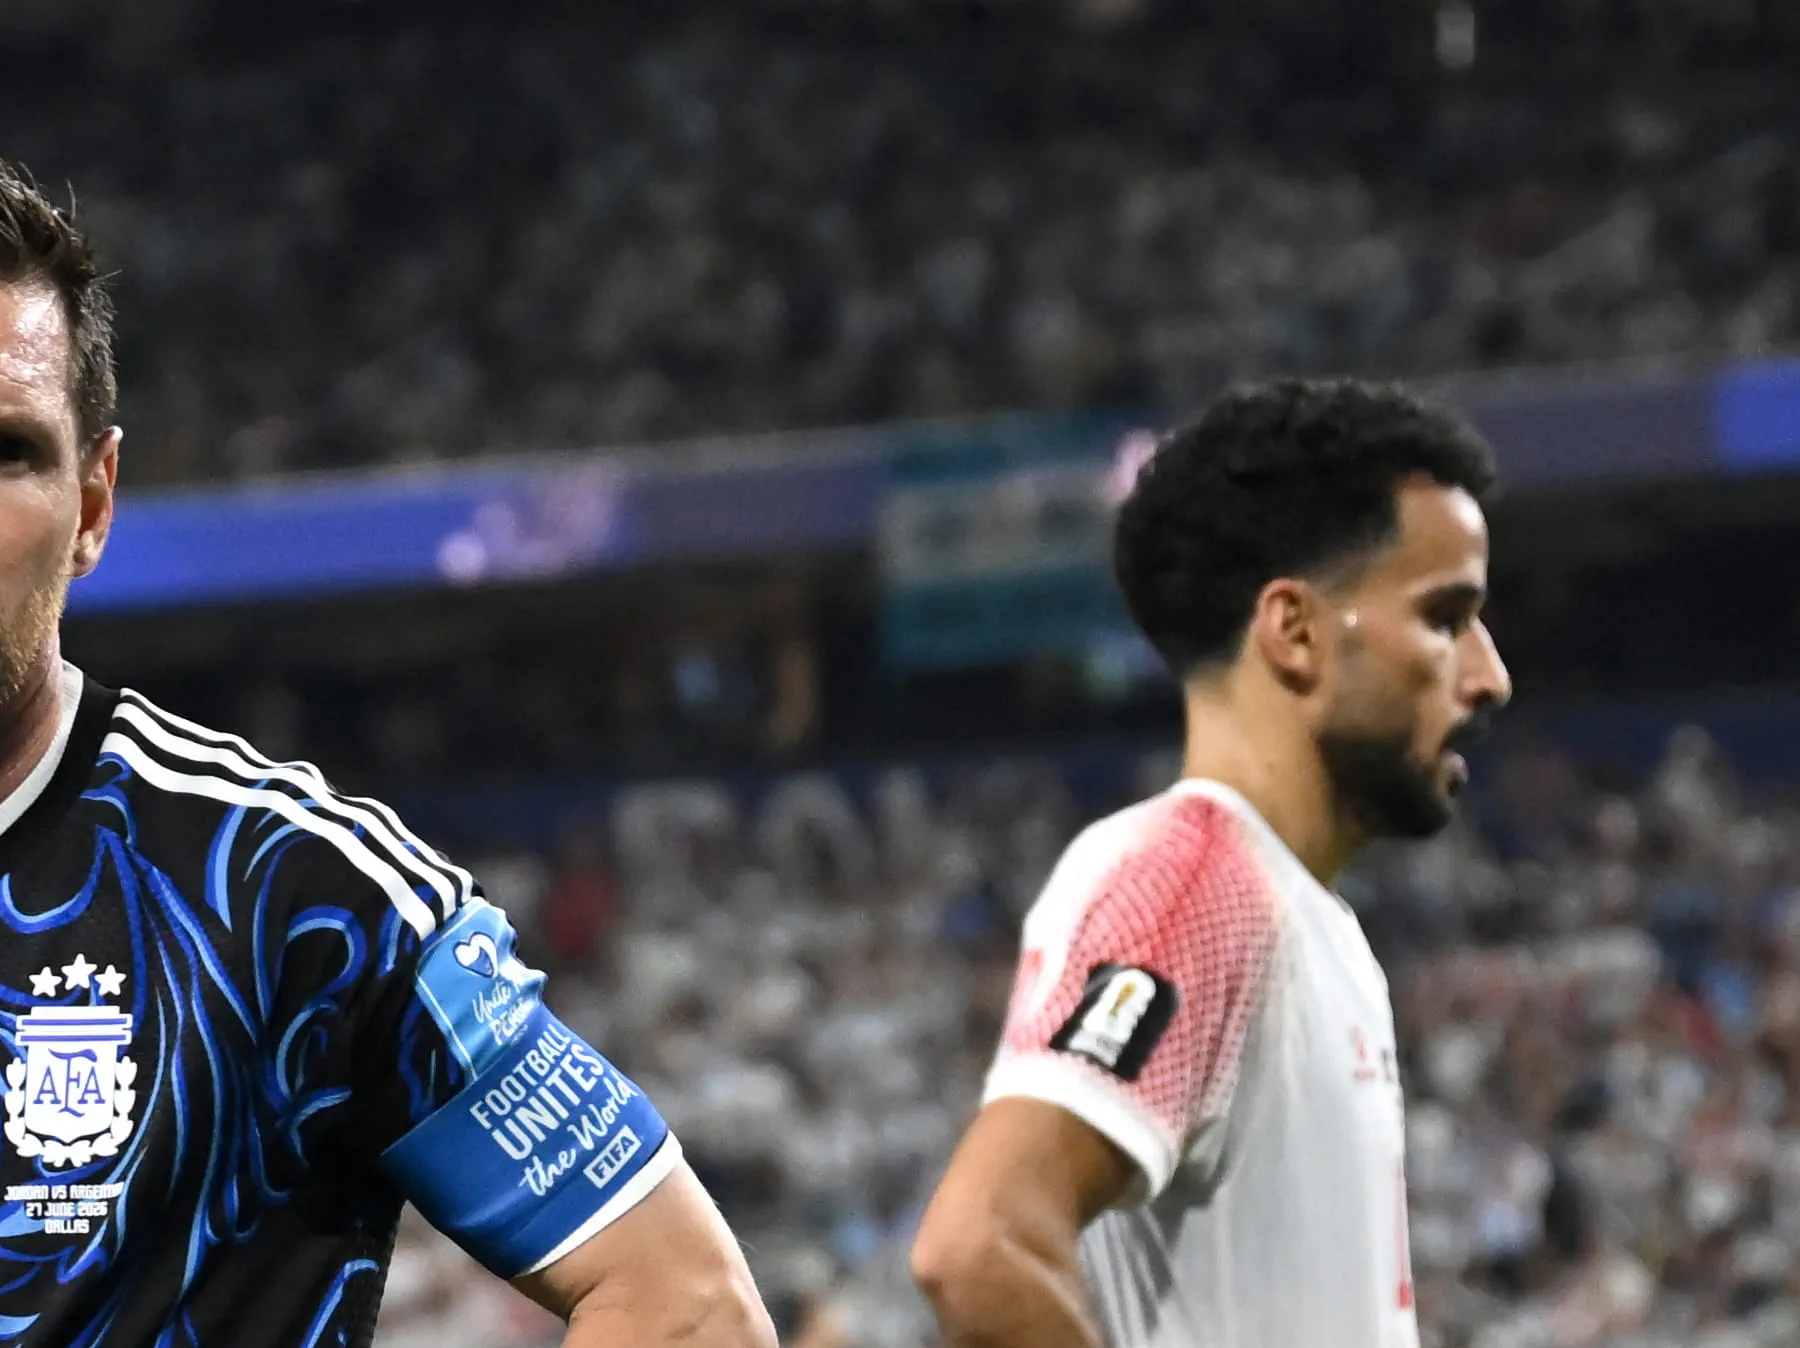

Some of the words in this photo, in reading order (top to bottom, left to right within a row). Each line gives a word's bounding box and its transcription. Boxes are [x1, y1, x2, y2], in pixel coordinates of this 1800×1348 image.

[33, 1048, 106, 1118] AFA
[469, 1023, 572, 1130] FOOTBALL
[491, 1043, 604, 1161] UNITES
[519, 1147, 577, 1196] the
[567, 1070, 638, 1151] World
[590, 1133, 638, 1184] FIFA
[4, 1185, 49, 1200] JORDAN
[51, 1185, 67, 1199] VS
[26, 1201, 42, 1217] 27
[44, 1202, 76, 1216] JUNE
[77, 1201, 108, 1216] 2026
[45, 1219, 90, 1234] DALLAS
